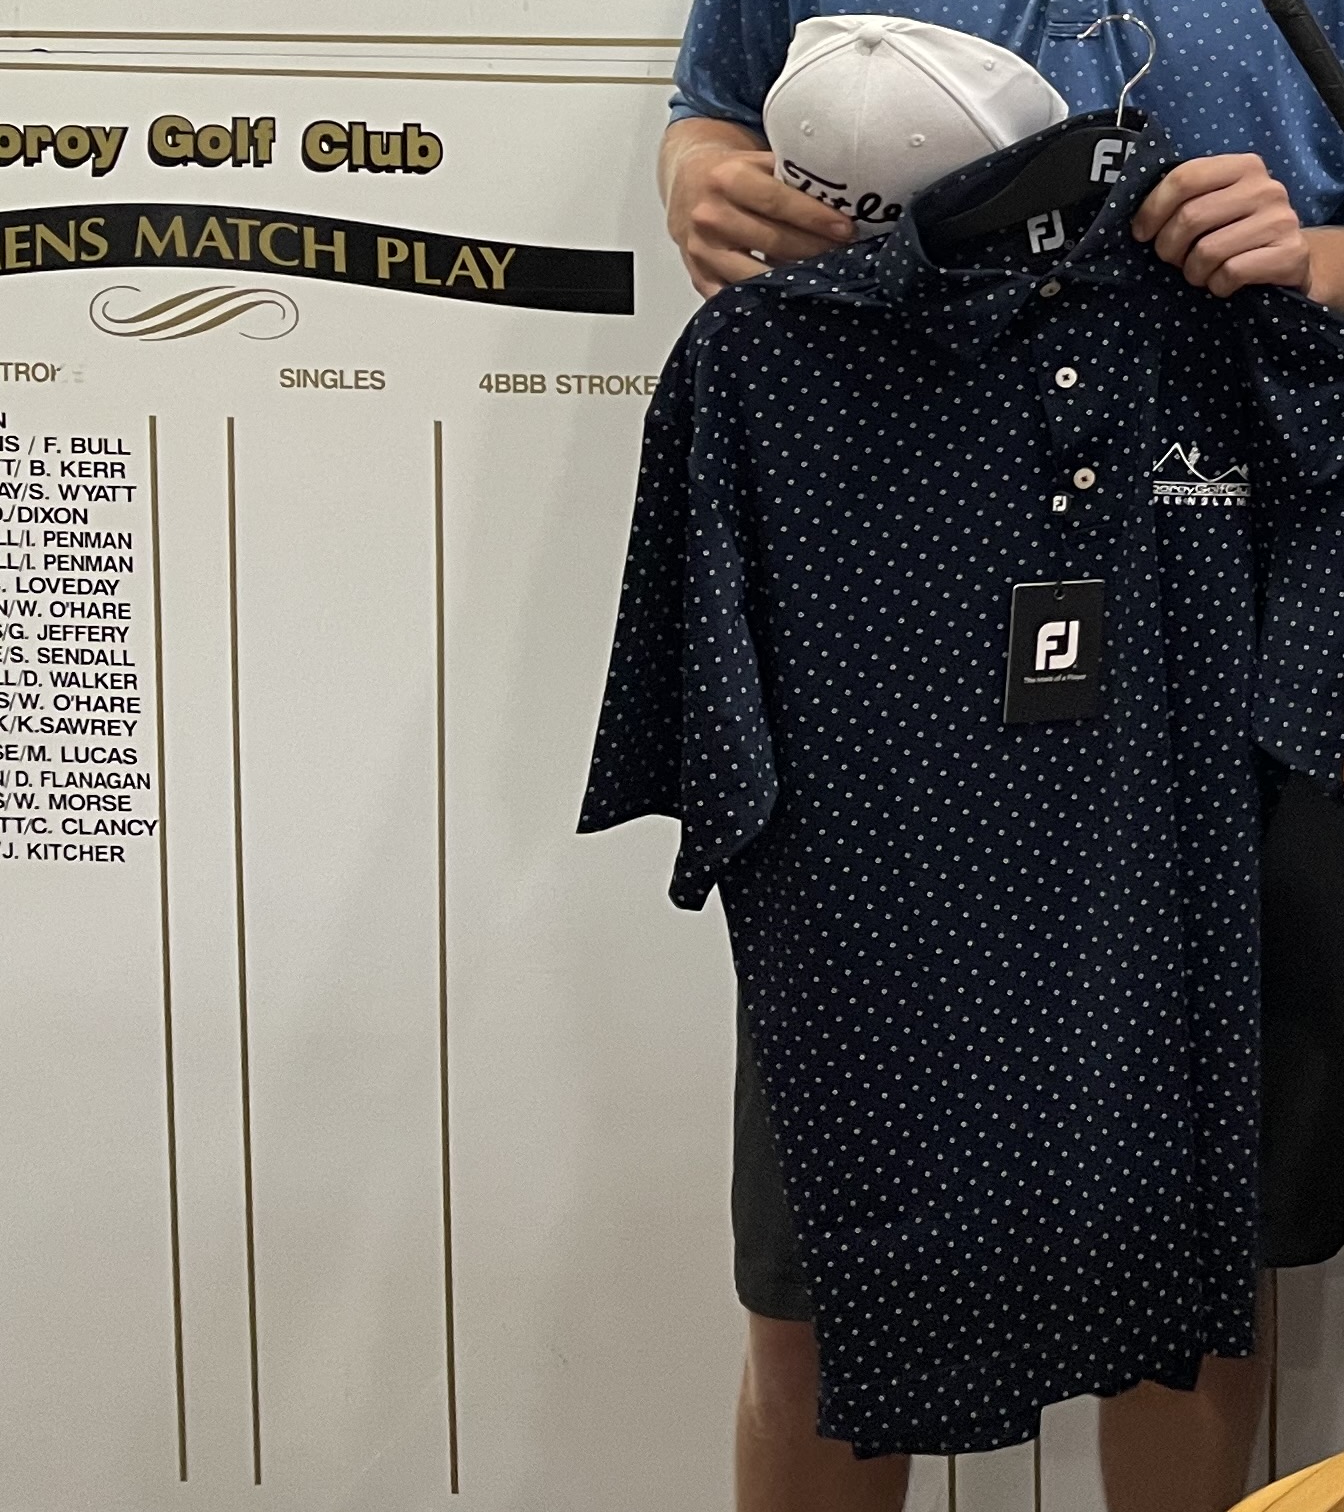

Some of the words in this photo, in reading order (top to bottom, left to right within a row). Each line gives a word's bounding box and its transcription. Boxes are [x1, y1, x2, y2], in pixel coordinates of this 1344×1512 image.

[148, 114, 277, 168] Golf
[301, 120, 445, 175] Club
[1026, 208, 1066, 254] FJ
[0, 218, 109, 271] ENS
[133, 215, 348, 274] MATCH
[376, 238, 517, 290] PLAY
[279, 367, 387, 391] SINGLES
[478, 373, 547, 395] 4BBB
[555, 373, 658, 397] STROKE
[43, 436, 62, 455] F.
[70, 437, 132, 456] BULL
[57, 483, 137, 502] WYATT
[15, 576, 120, 596] LOVEDAY
[49, 600, 132, 620] O'HARE
[36, 624, 130, 643] JEFFERY
[1034, 619, 1081, 671] FJ
[50, 671, 138, 690] WALKER
[61, 818, 158, 836] CLANCY
[26, 843, 126, 863] KITCHER
